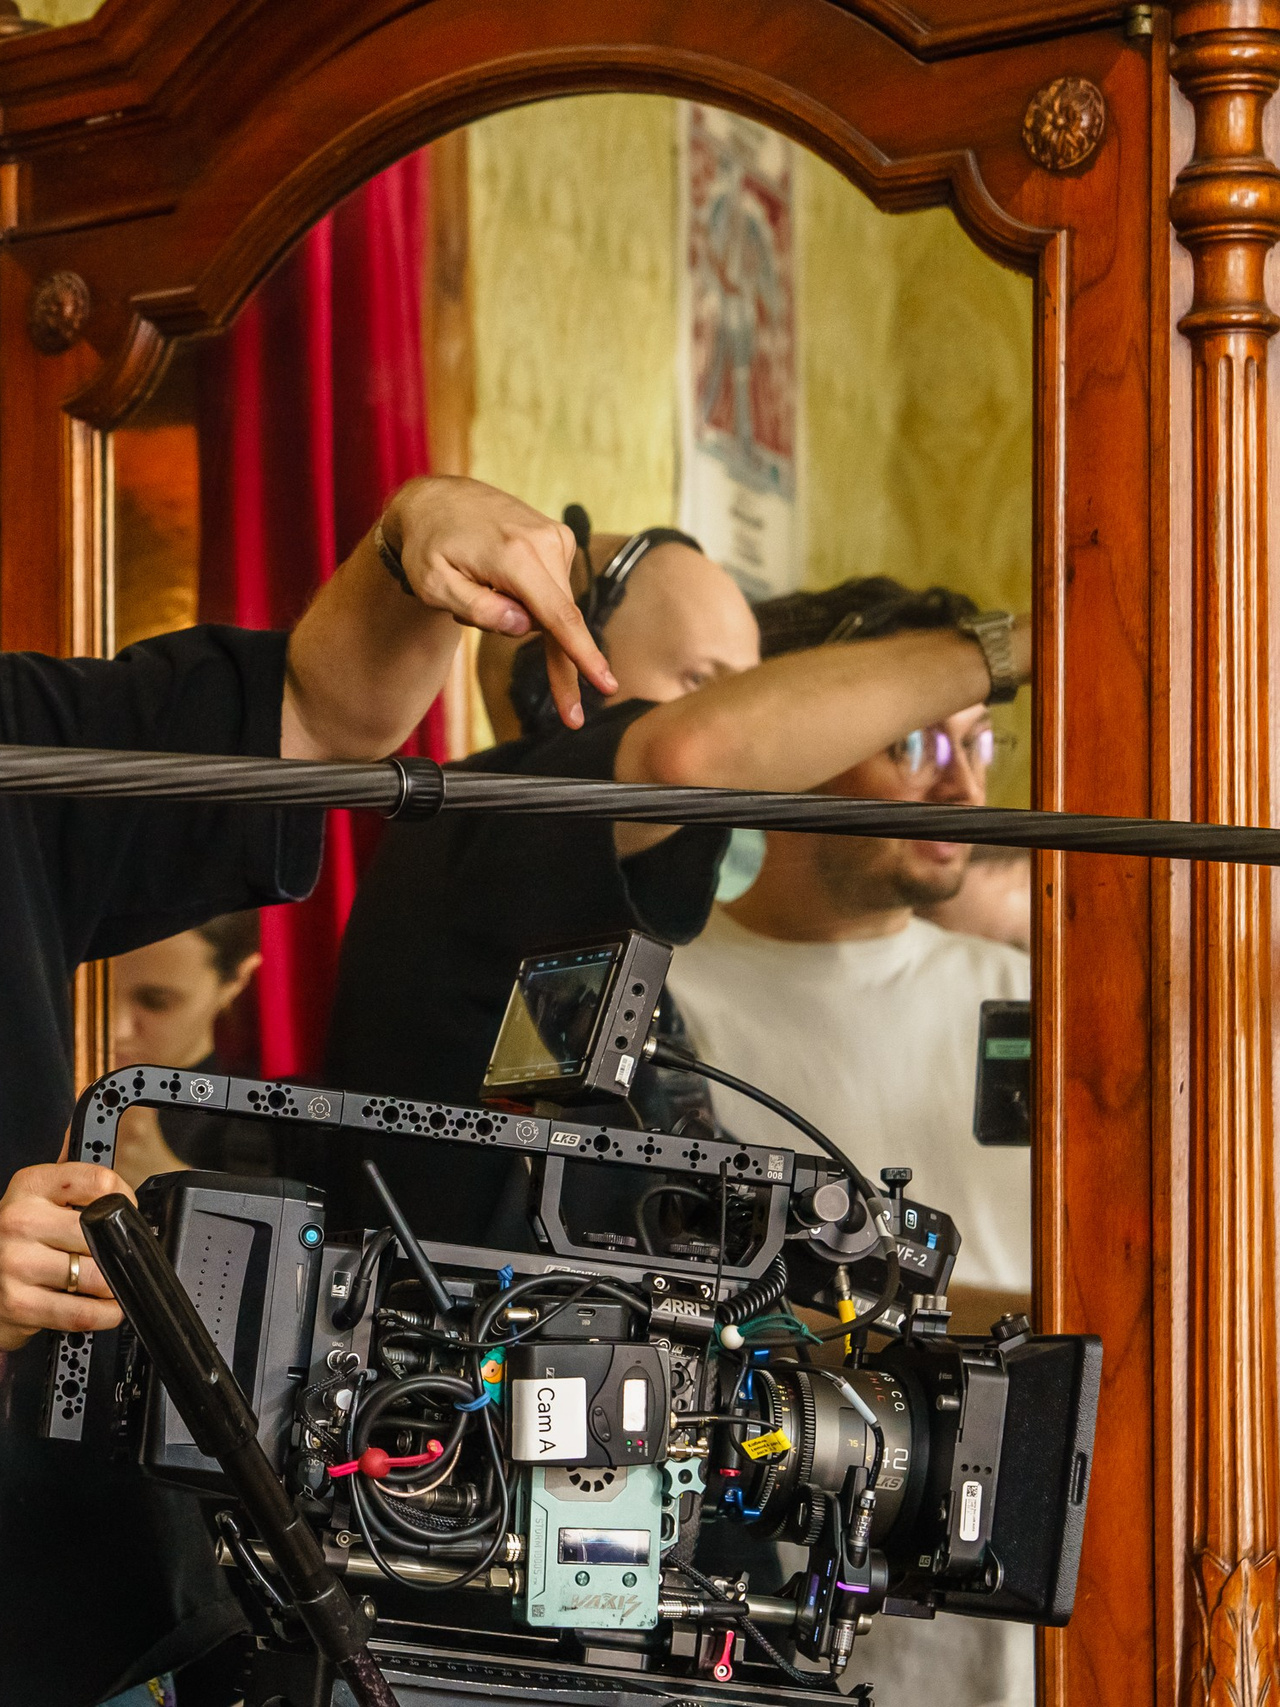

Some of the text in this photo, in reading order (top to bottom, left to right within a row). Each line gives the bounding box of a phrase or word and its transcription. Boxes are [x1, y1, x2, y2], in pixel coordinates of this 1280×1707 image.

[552, 1132, 579, 1146] LKS
[767, 1170, 783, 1180] 008
[896, 1243, 928, 1268] VF-2
[657, 1297, 700, 1317] ARRI
[536, 1387, 557, 1454] Cam A
[876, 1476, 901, 1489] KS
[534, 1517, 544, 1548] STORM
